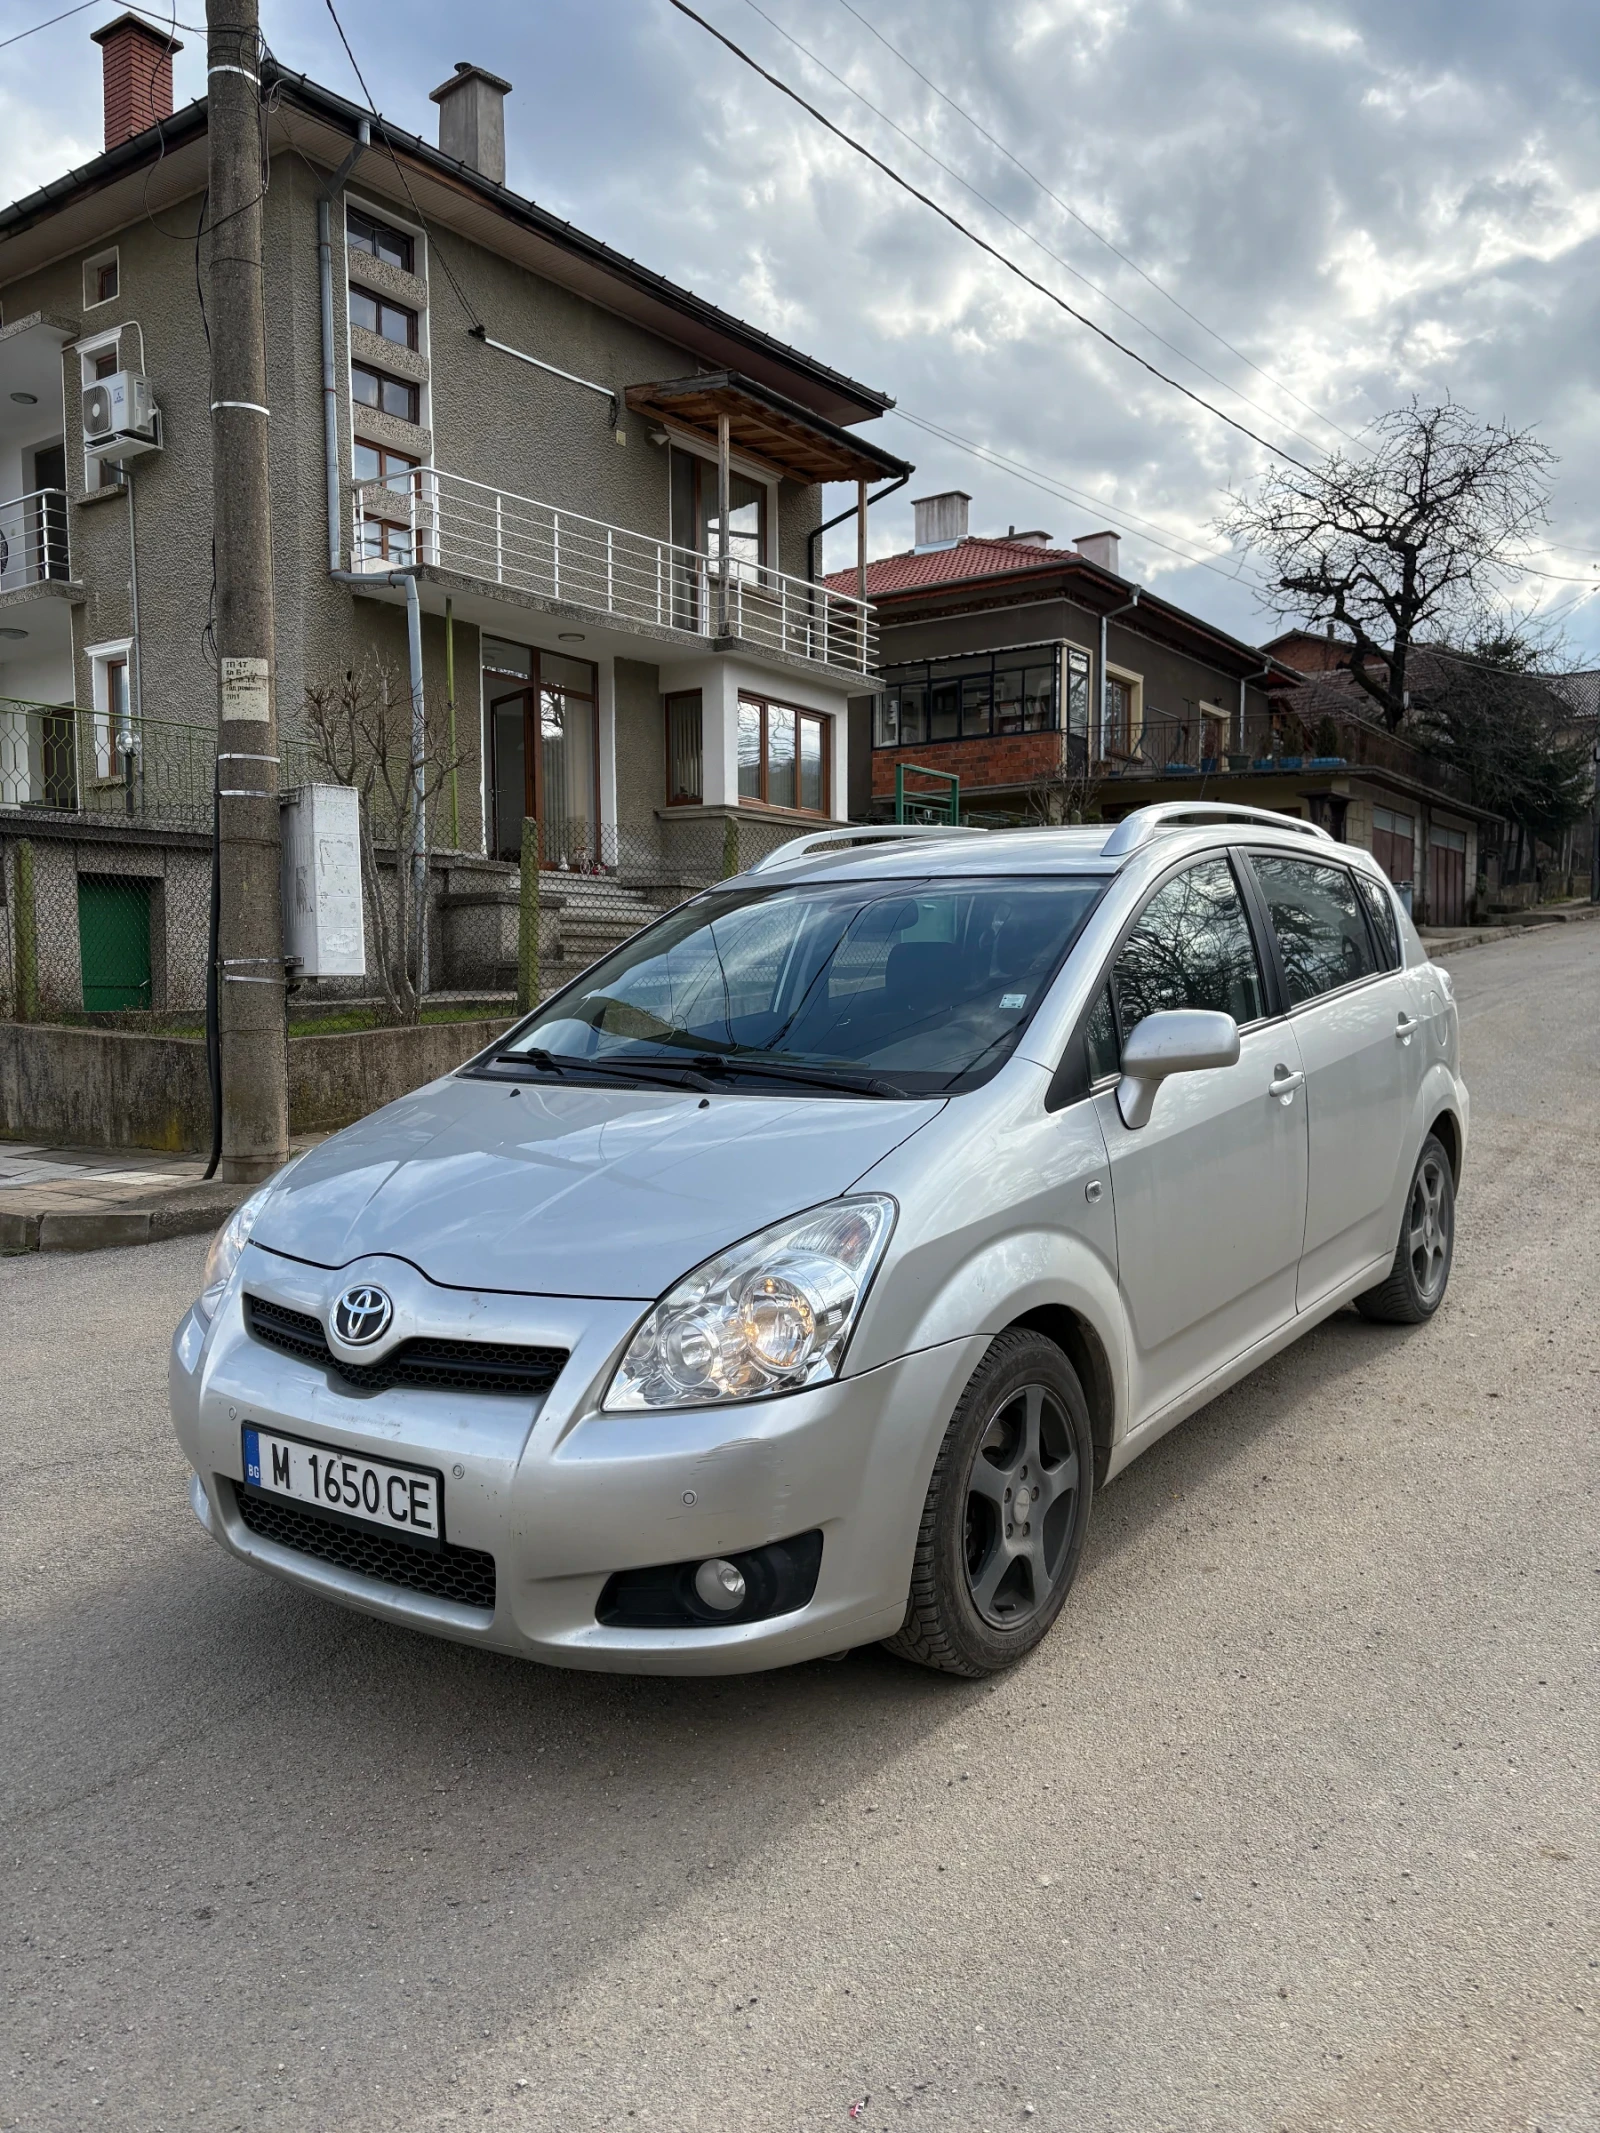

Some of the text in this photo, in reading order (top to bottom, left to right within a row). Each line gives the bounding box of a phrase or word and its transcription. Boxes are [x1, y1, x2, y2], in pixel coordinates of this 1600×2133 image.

[248, 1464, 260, 1479] BG
[271, 1443, 432, 1530] M 1650 CE
